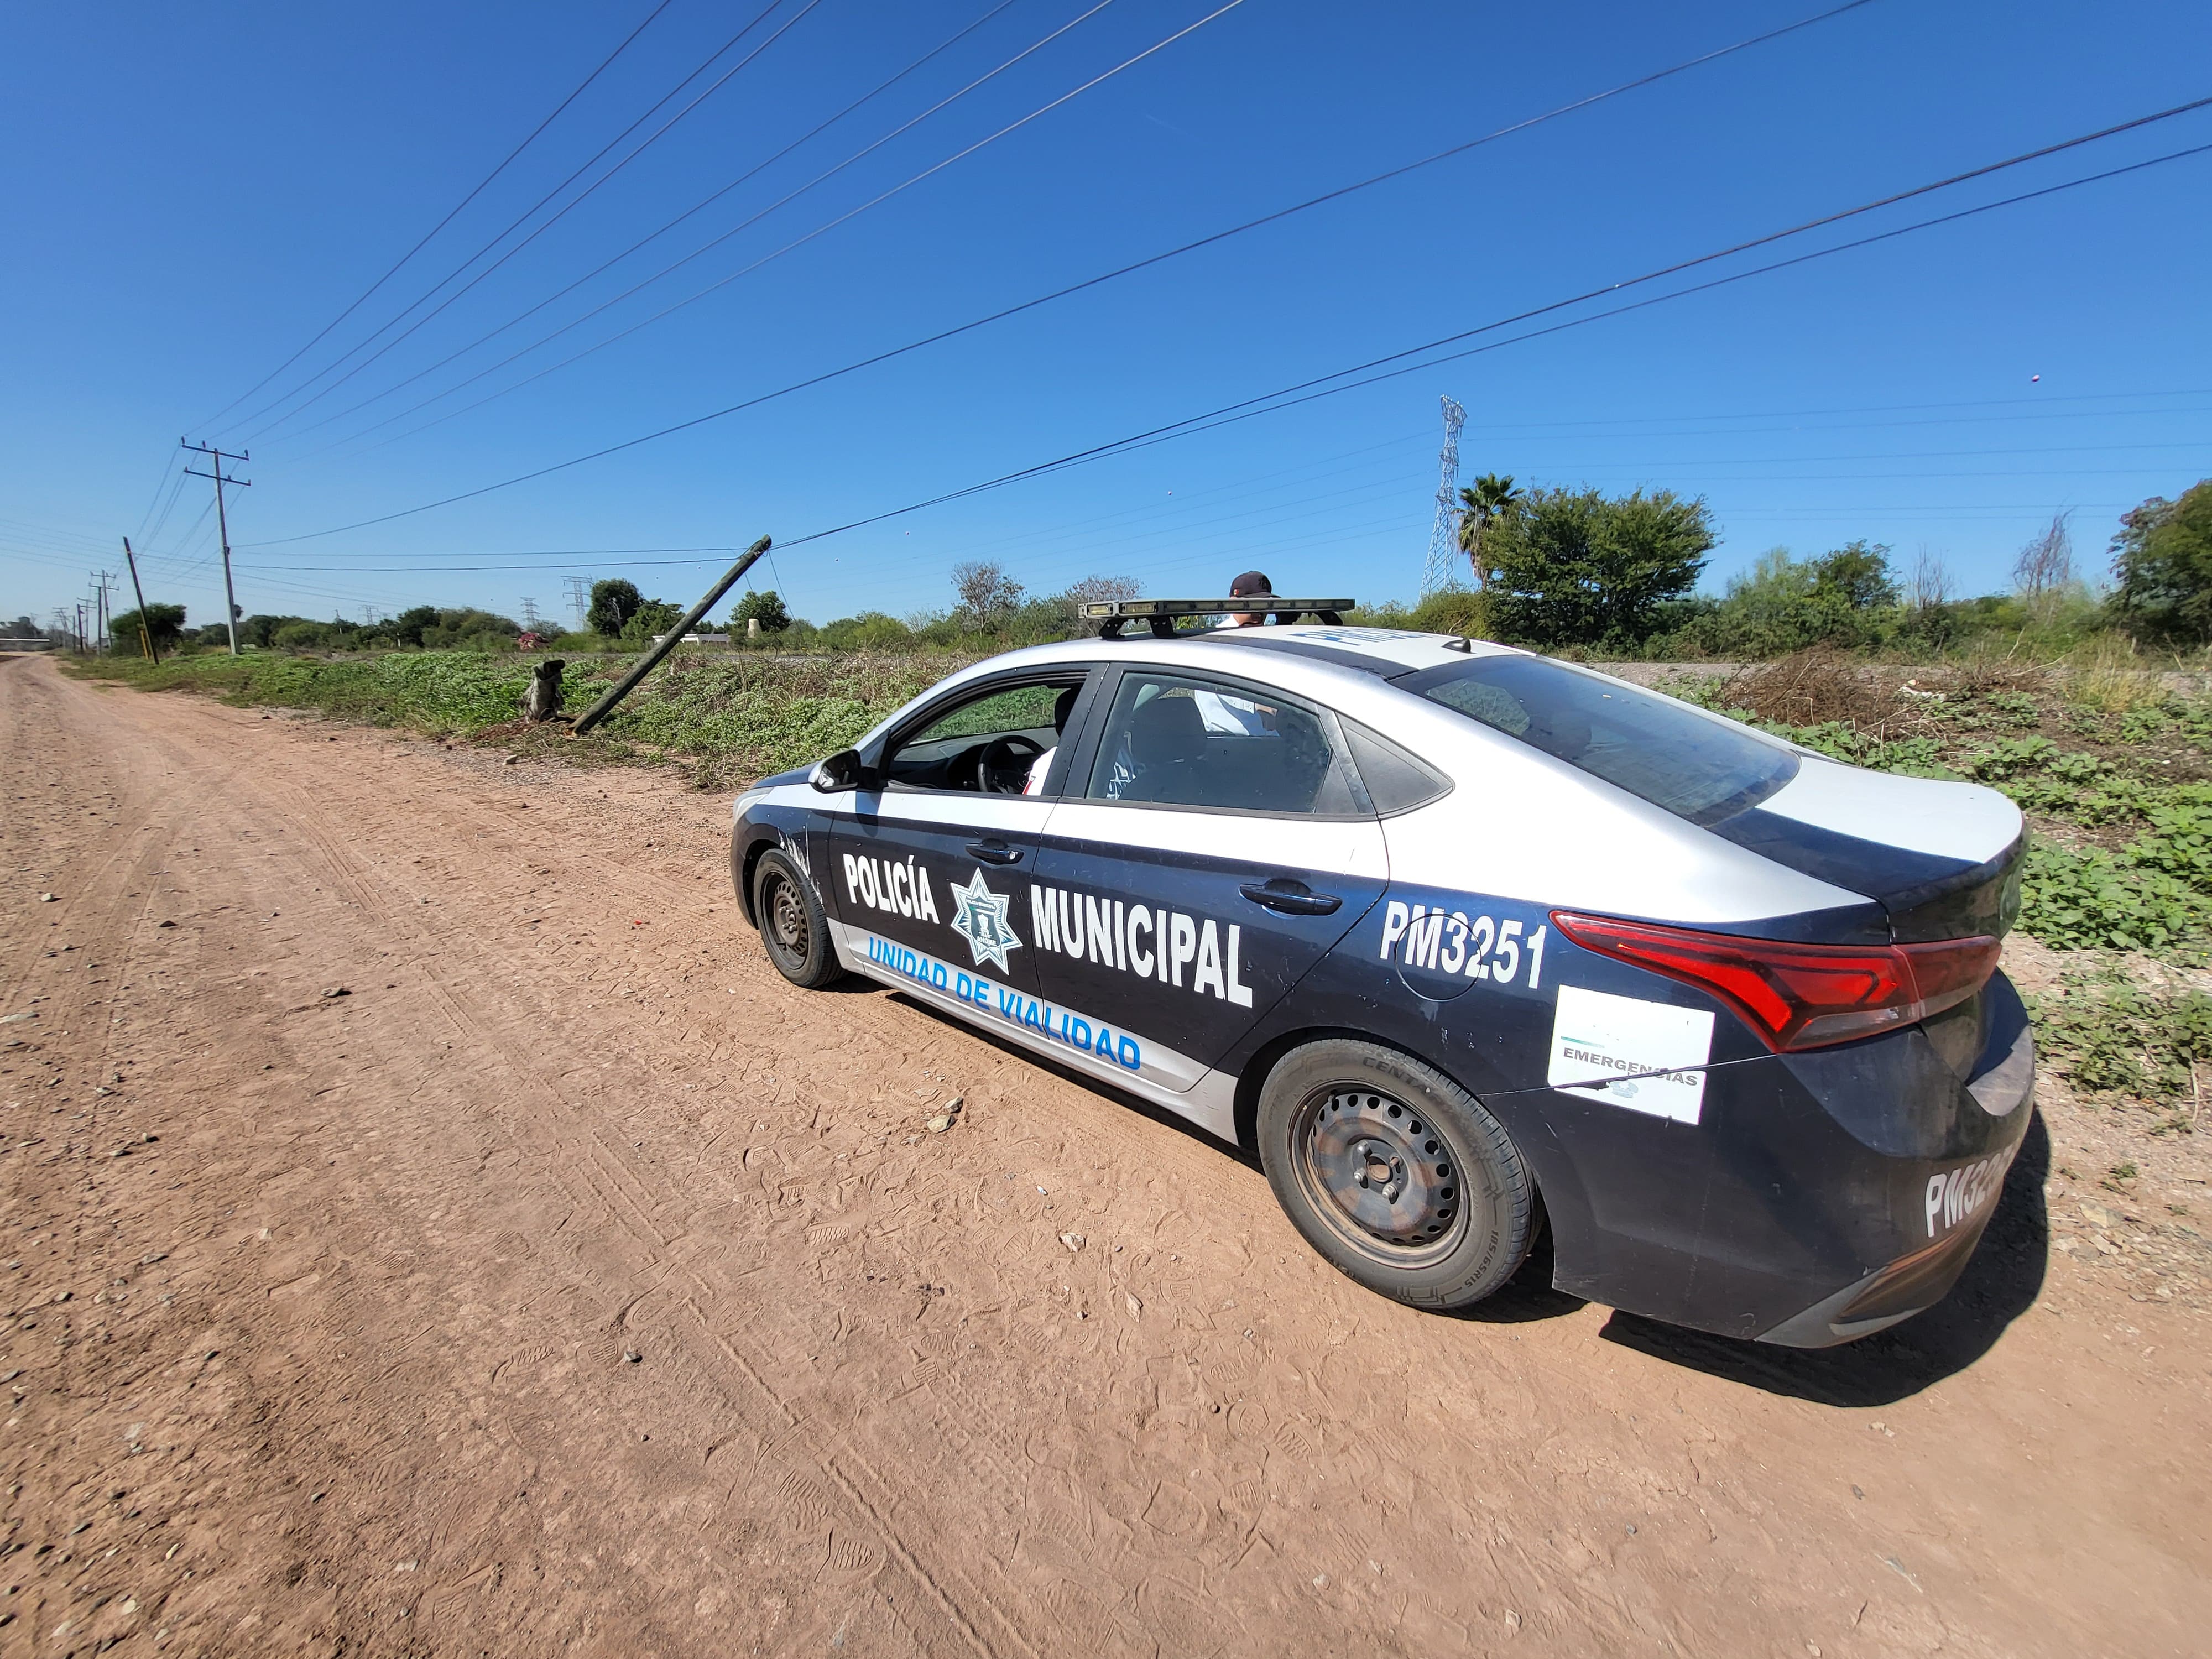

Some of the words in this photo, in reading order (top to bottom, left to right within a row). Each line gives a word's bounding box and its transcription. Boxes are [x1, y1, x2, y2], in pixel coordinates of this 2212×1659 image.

[843, 853, 940, 924] POLICÍA
[1031, 884, 1253, 1008] MUNICIPAL
[977, 936, 997, 947] AHOME
[1380, 901, 1547, 989] PM3251
[869, 936, 948, 991] UNIDAD
[956, 972, 991, 1010] DE
[999, 988, 1141, 1071] VIALIDAD
[1563, 1047, 1698, 1086] EMERGENCIAS
